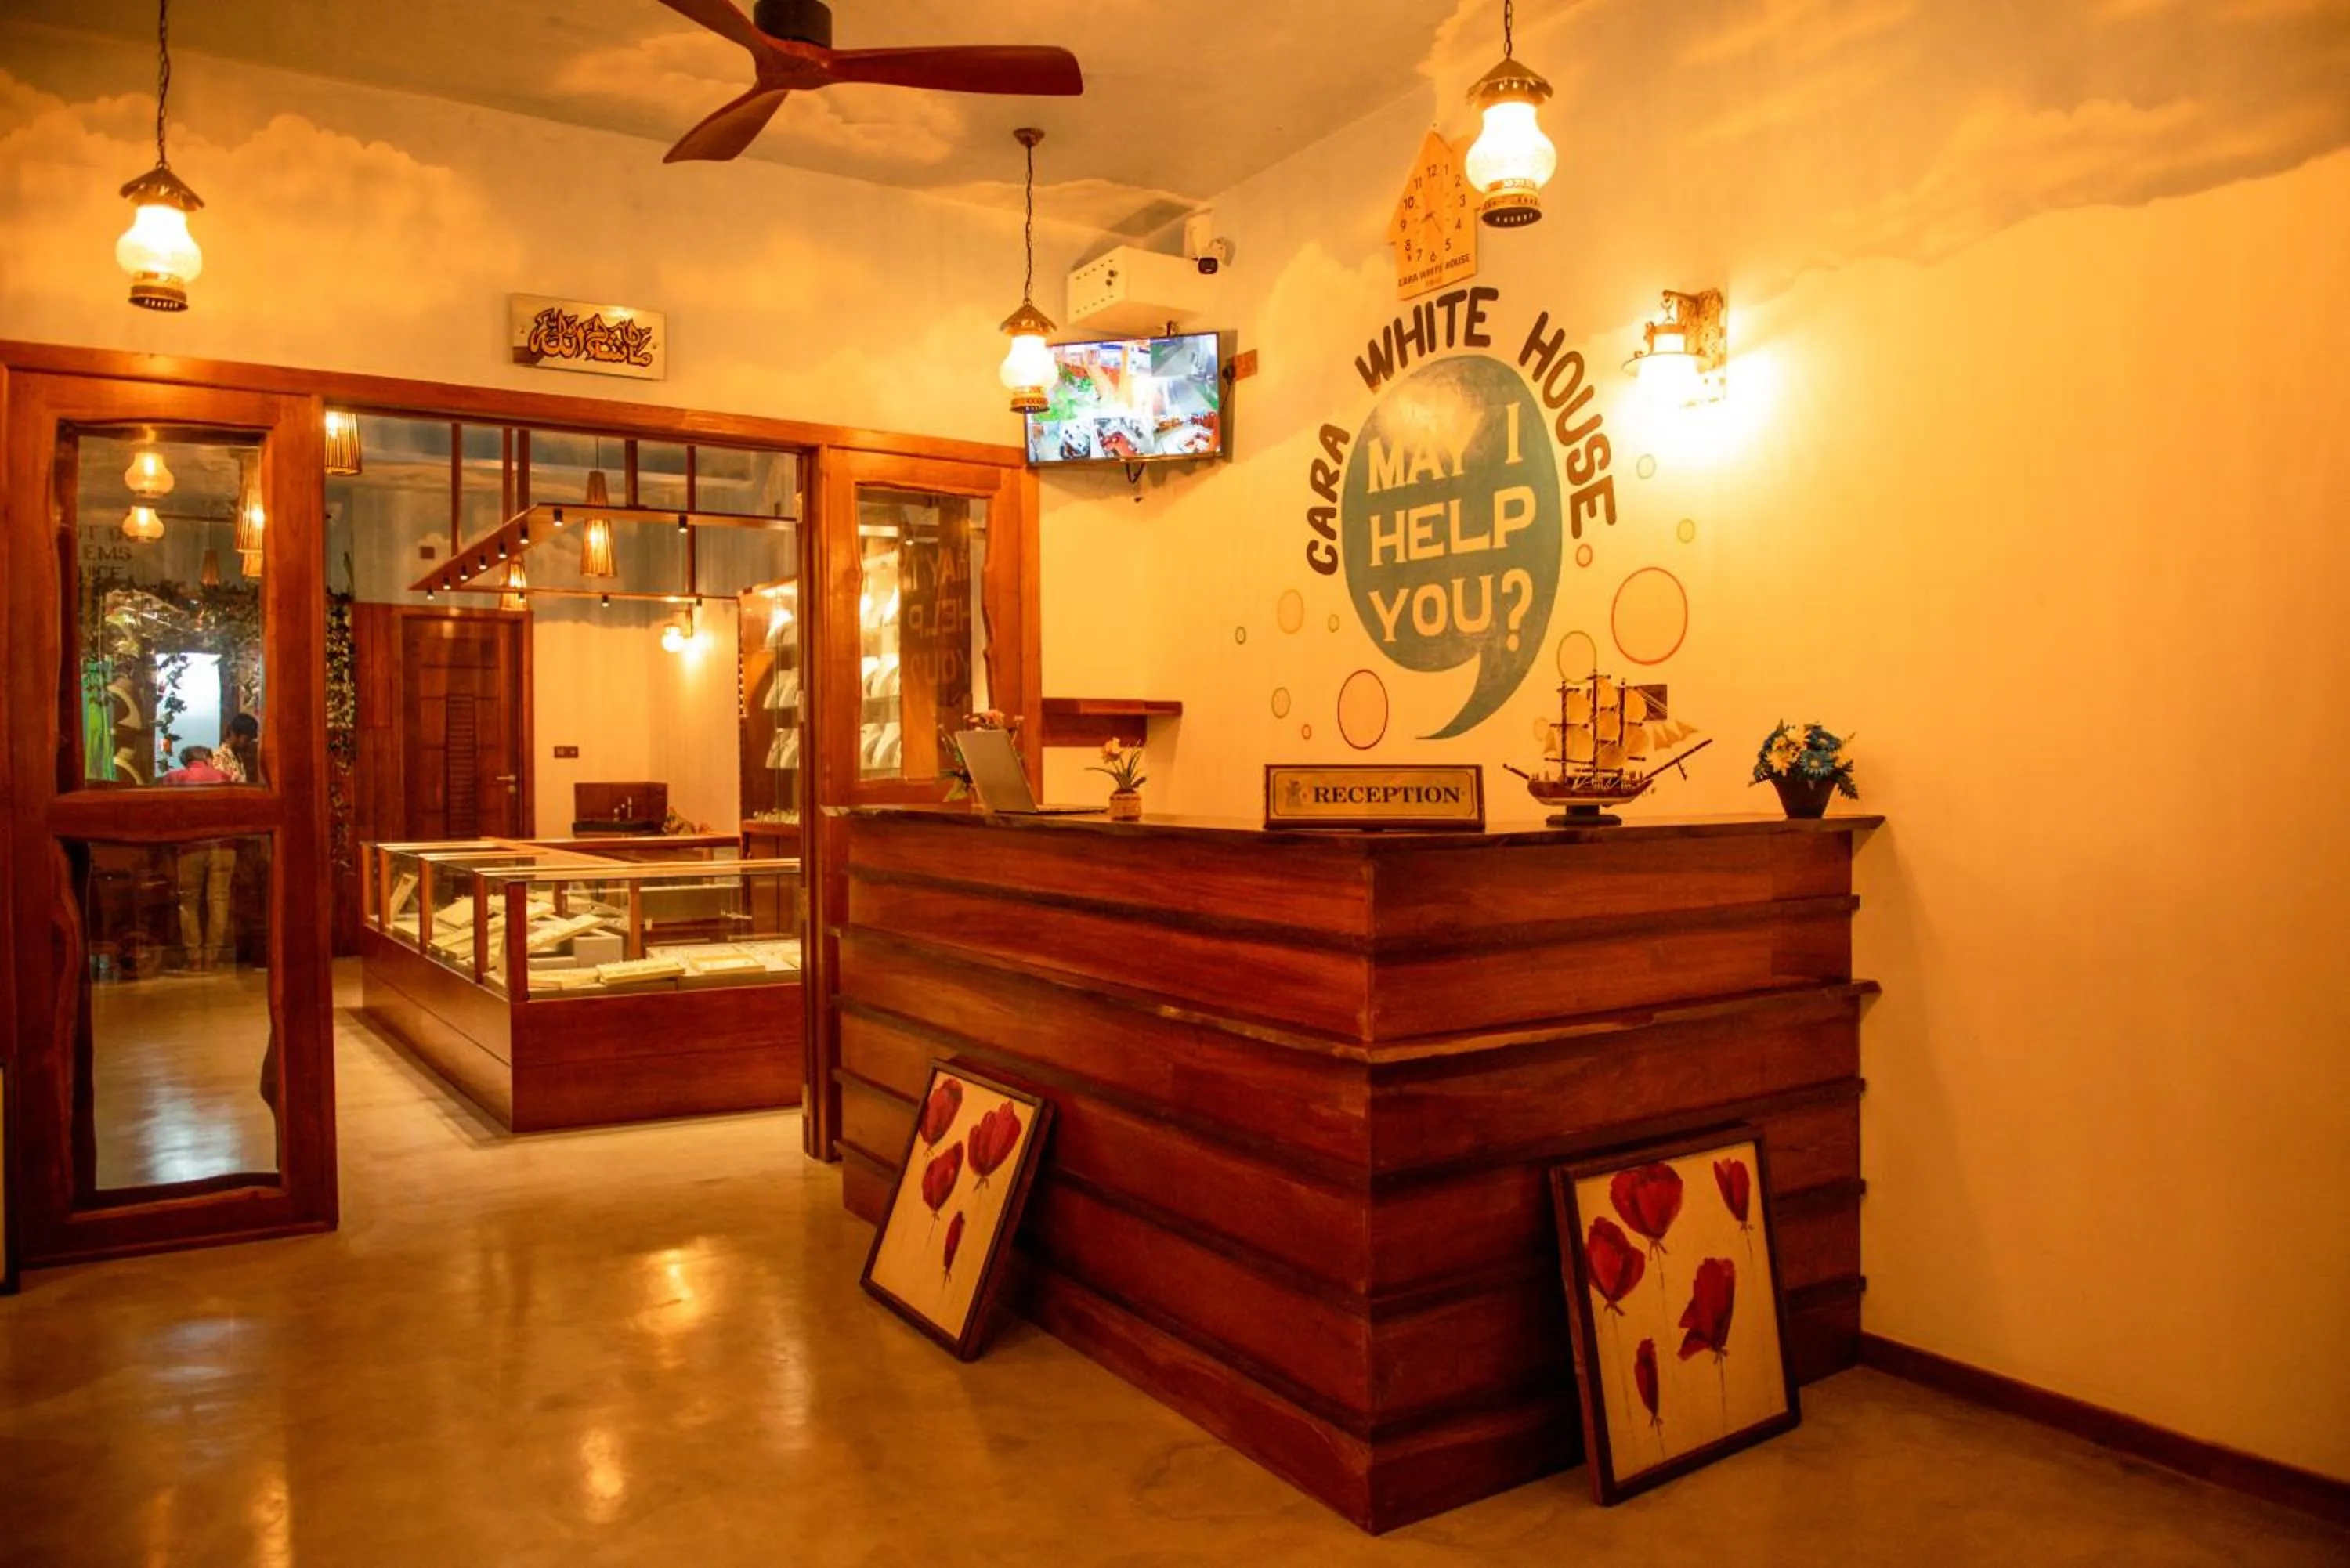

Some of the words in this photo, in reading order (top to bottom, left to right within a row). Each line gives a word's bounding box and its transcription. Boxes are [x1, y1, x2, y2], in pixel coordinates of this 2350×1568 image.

[1427, 164, 1437, 177] 12
[1444, 164, 1448, 175] 1
[1414, 177, 1422, 189] 11
[1455, 175, 1460, 187] 2
[1404, 197, 1414, 210] 10
[1460, 194, 1466, 207] 3
[1400, 219, 1407, 232] 9
[1455, 218, 1461, 229] 4
[1405, 239, 1411, 251] 8
[1445, 238, 1452, 251] 5
[1416, 249, 1423, 261] 7
[1430, 251, 1437, 262] 6
[1306, 422, 1350, 576] CARA
[1354, 286, 1499, 394] WHITE
[1518, 311, 1617, 540] HOUSE
[1367, 410, 1484, 493] MAY
[1505, 402, 1521, 464] I
[1368, 486, 1536, 567] HELP
[1368, 568, 1533, 652] YOU?
[1313, 786, 1461, 804] RECEPTION
